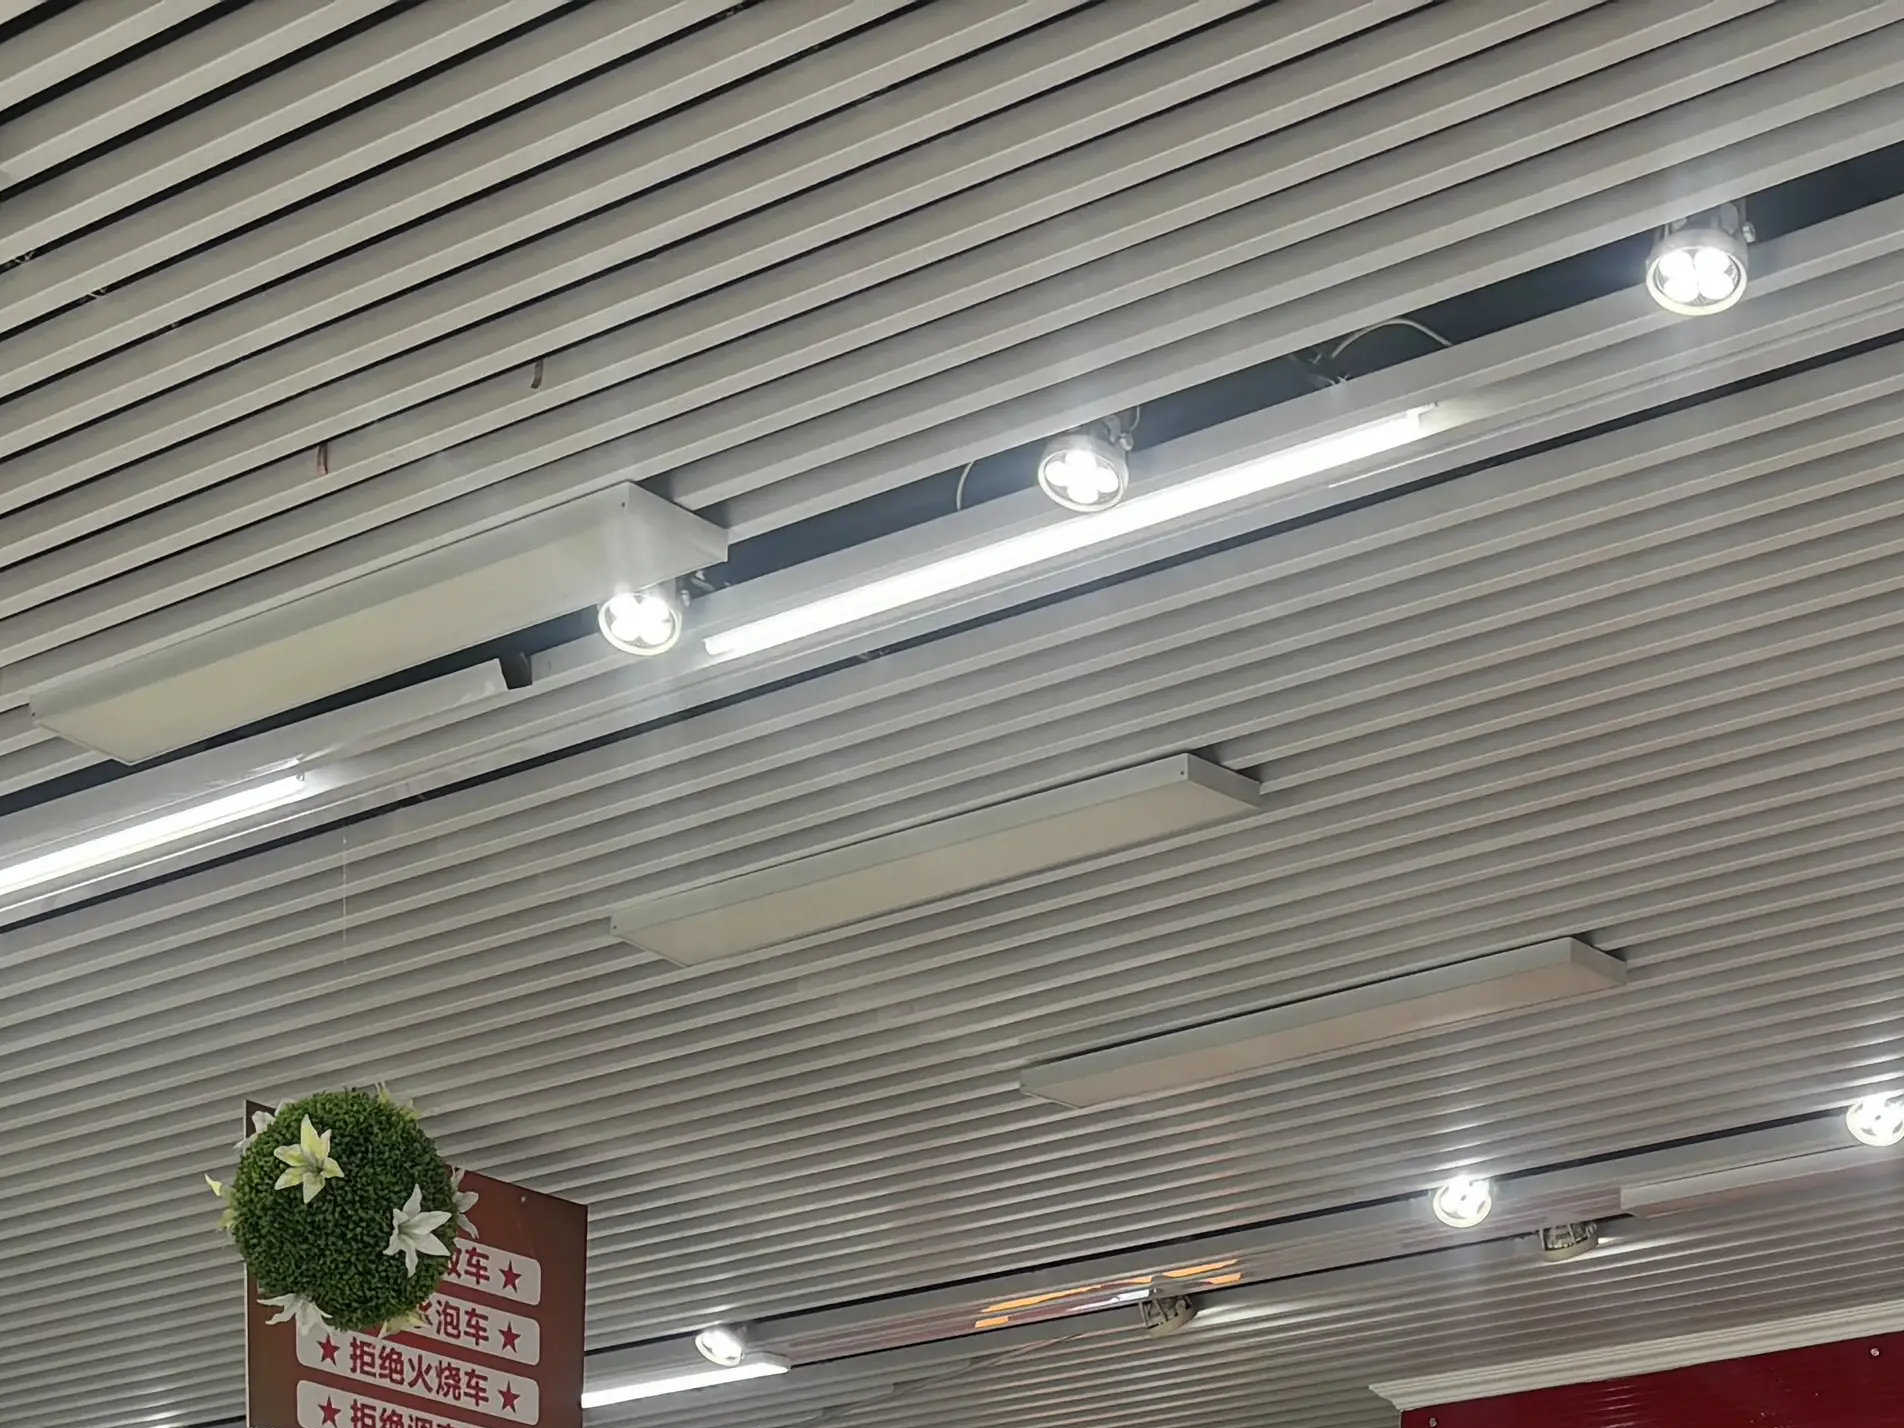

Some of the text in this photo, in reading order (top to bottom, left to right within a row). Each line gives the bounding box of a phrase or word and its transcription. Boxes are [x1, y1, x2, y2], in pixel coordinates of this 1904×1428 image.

[349, 1337, 490, 1407] 拒绝火烧车
